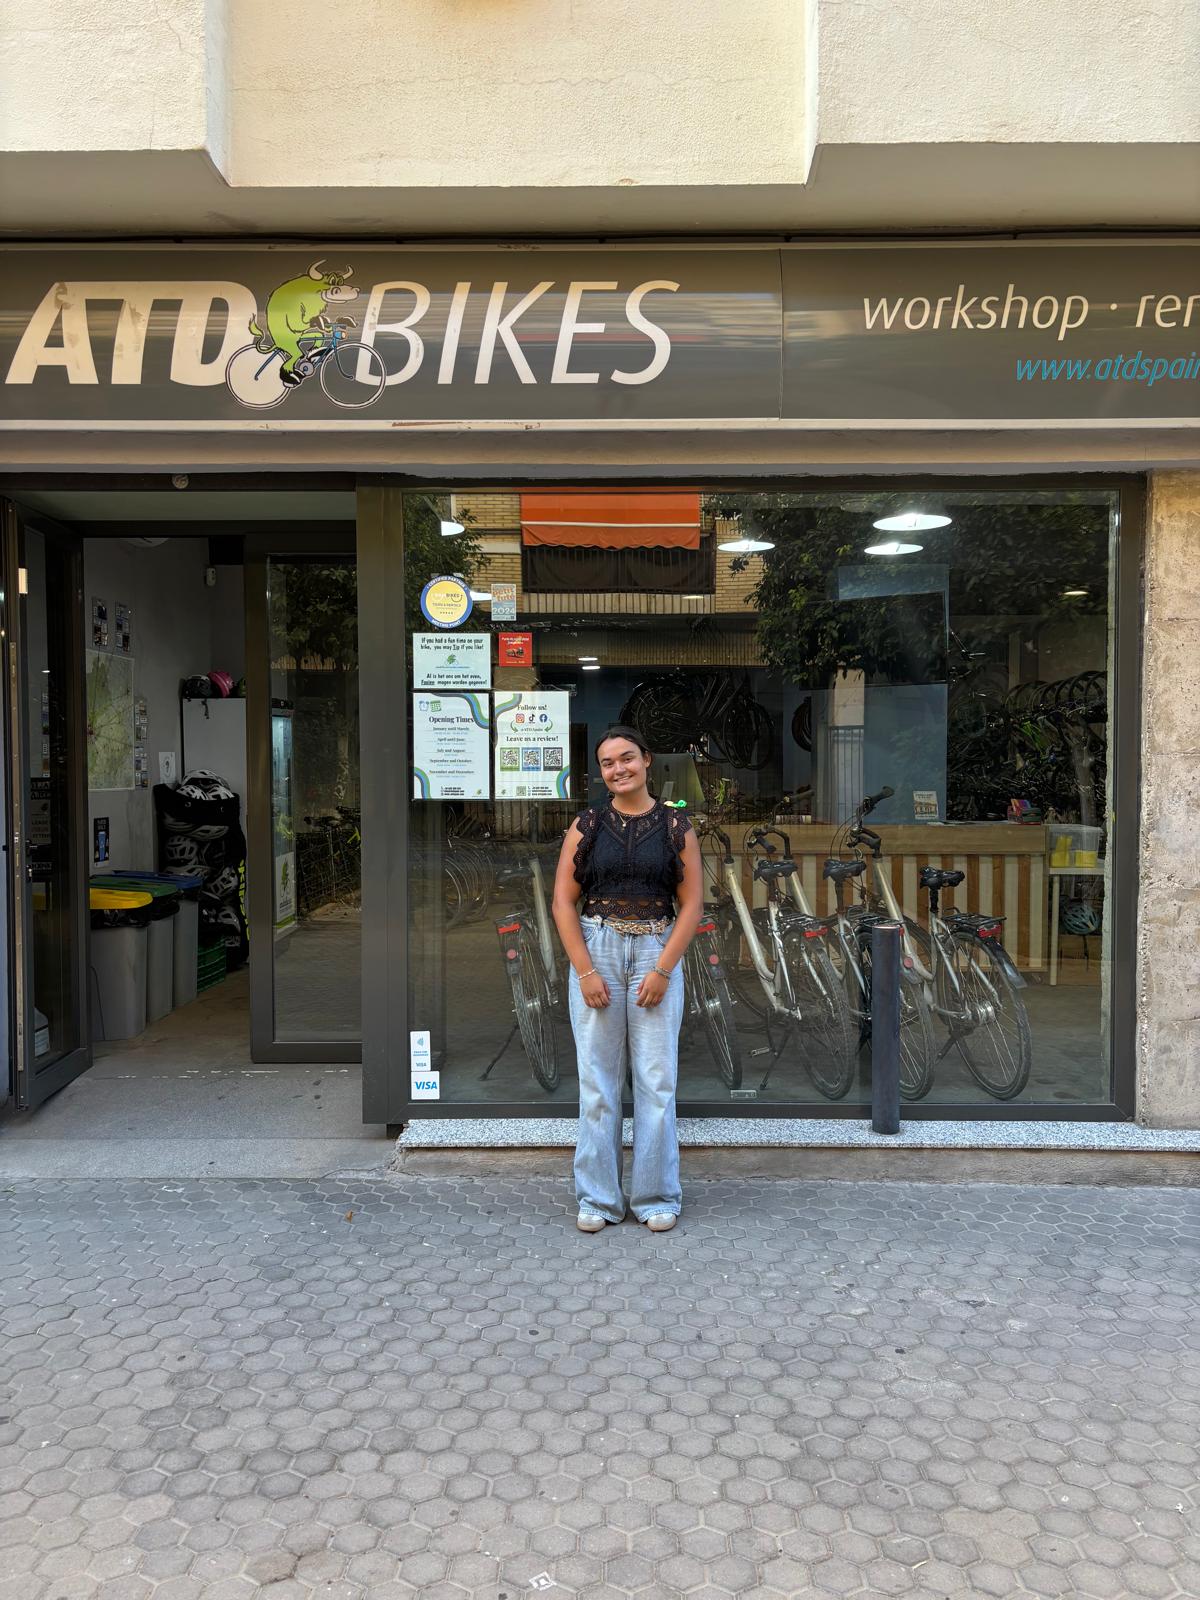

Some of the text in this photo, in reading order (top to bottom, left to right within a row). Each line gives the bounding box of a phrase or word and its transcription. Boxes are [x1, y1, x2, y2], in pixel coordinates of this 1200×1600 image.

[862, 283, 1090, 341] workshop
[4, 280, 681, 387] ATD BIKES
[1016, 350, 1200, 387] www.atdspai
[428, 716, 455, 724] Opening
[415, 1081, 438, 1090] VISA
